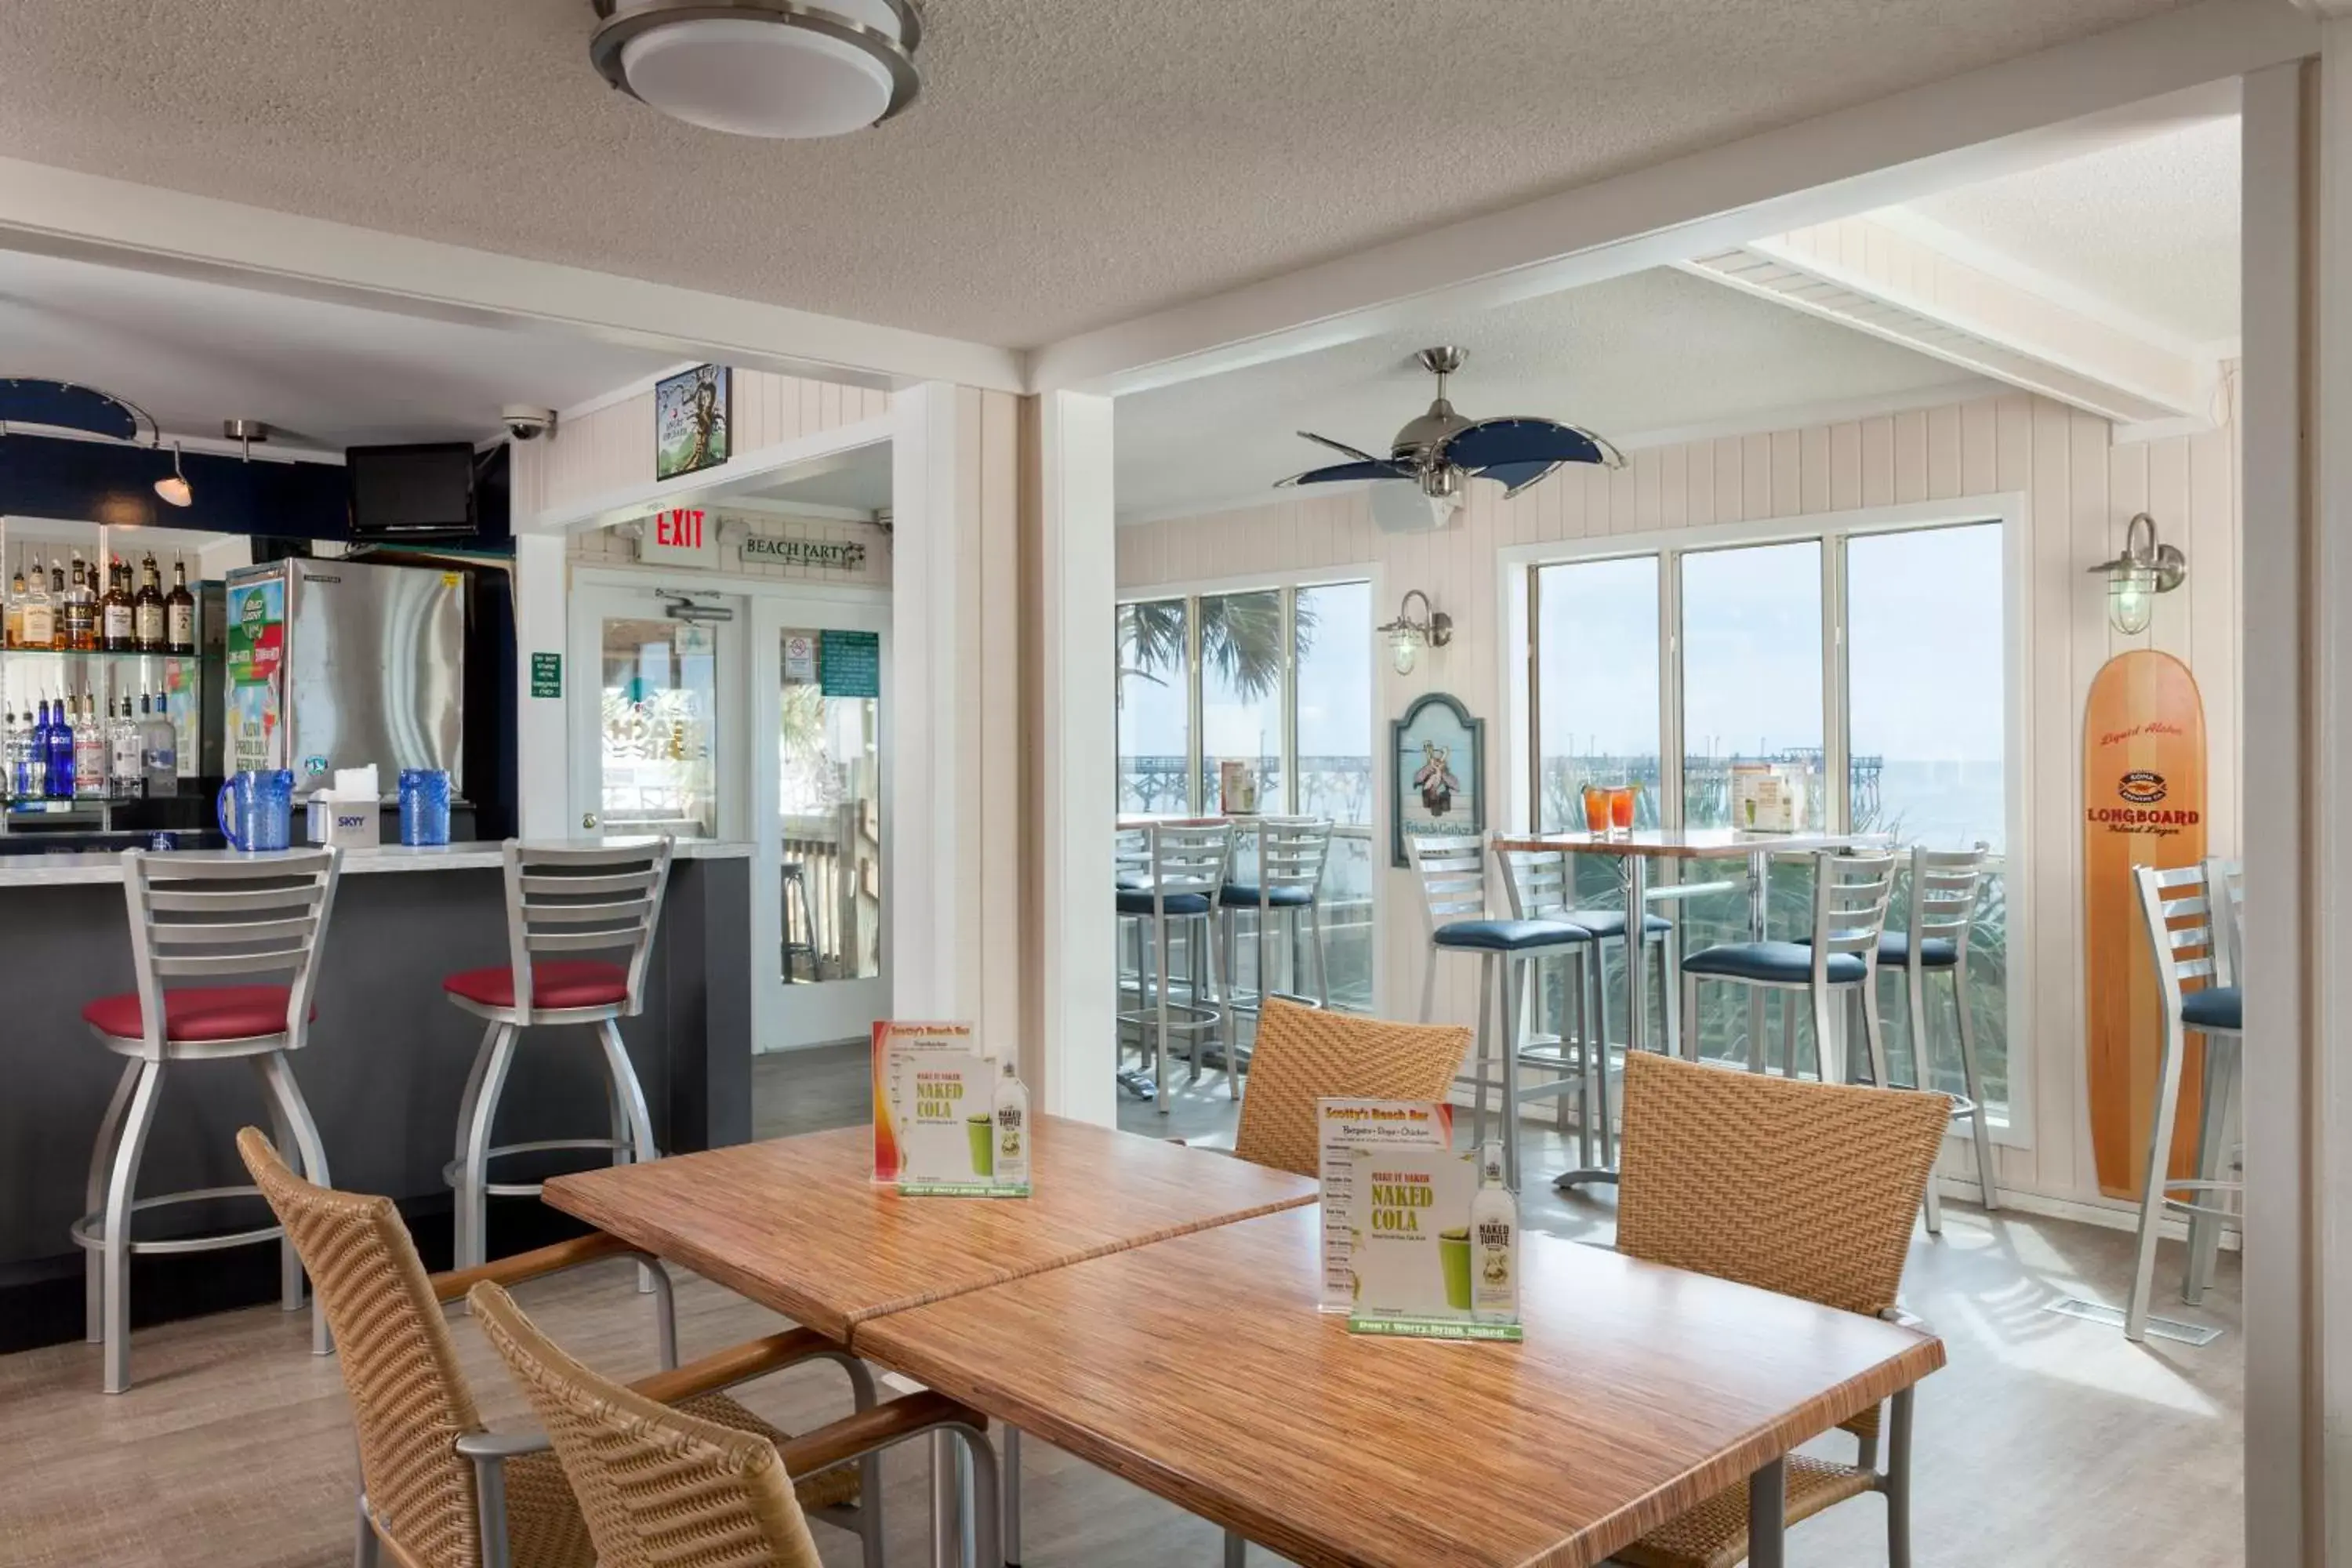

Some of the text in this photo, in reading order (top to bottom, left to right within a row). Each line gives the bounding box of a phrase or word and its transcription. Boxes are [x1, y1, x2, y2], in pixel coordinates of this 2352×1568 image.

[657, 510, 703, 548] EXIT
[747, 539, 849, 560] BEACH PARTY
[2100, 722, 2183, 747] Liquid Aloha
[338, 816, 365, 827] SKYY
[2088, 808, 2199, 826] LONGBOARD
[1406, 821, 1438, 835] Friends
[2108, 823, 2180, 837] Island Lager
[916, 1083, 964, 1100] NAKED
[916, 1102, 951, 1118] COLA
[1326, 1106, 1428, 1122] Scotty's Beach Bar
[1400, 1127, 1430, 1136] Chicken
[1404, 1174, 1429, 1182] NAKED
[1371, 1185, 1433, 1207] NAKED
[1371, 1208, 1418, 1231] COLA
[1479, 1224, 1509, 1235] NAKED
[1479, 1234, 1509, 1247] TURTLE
